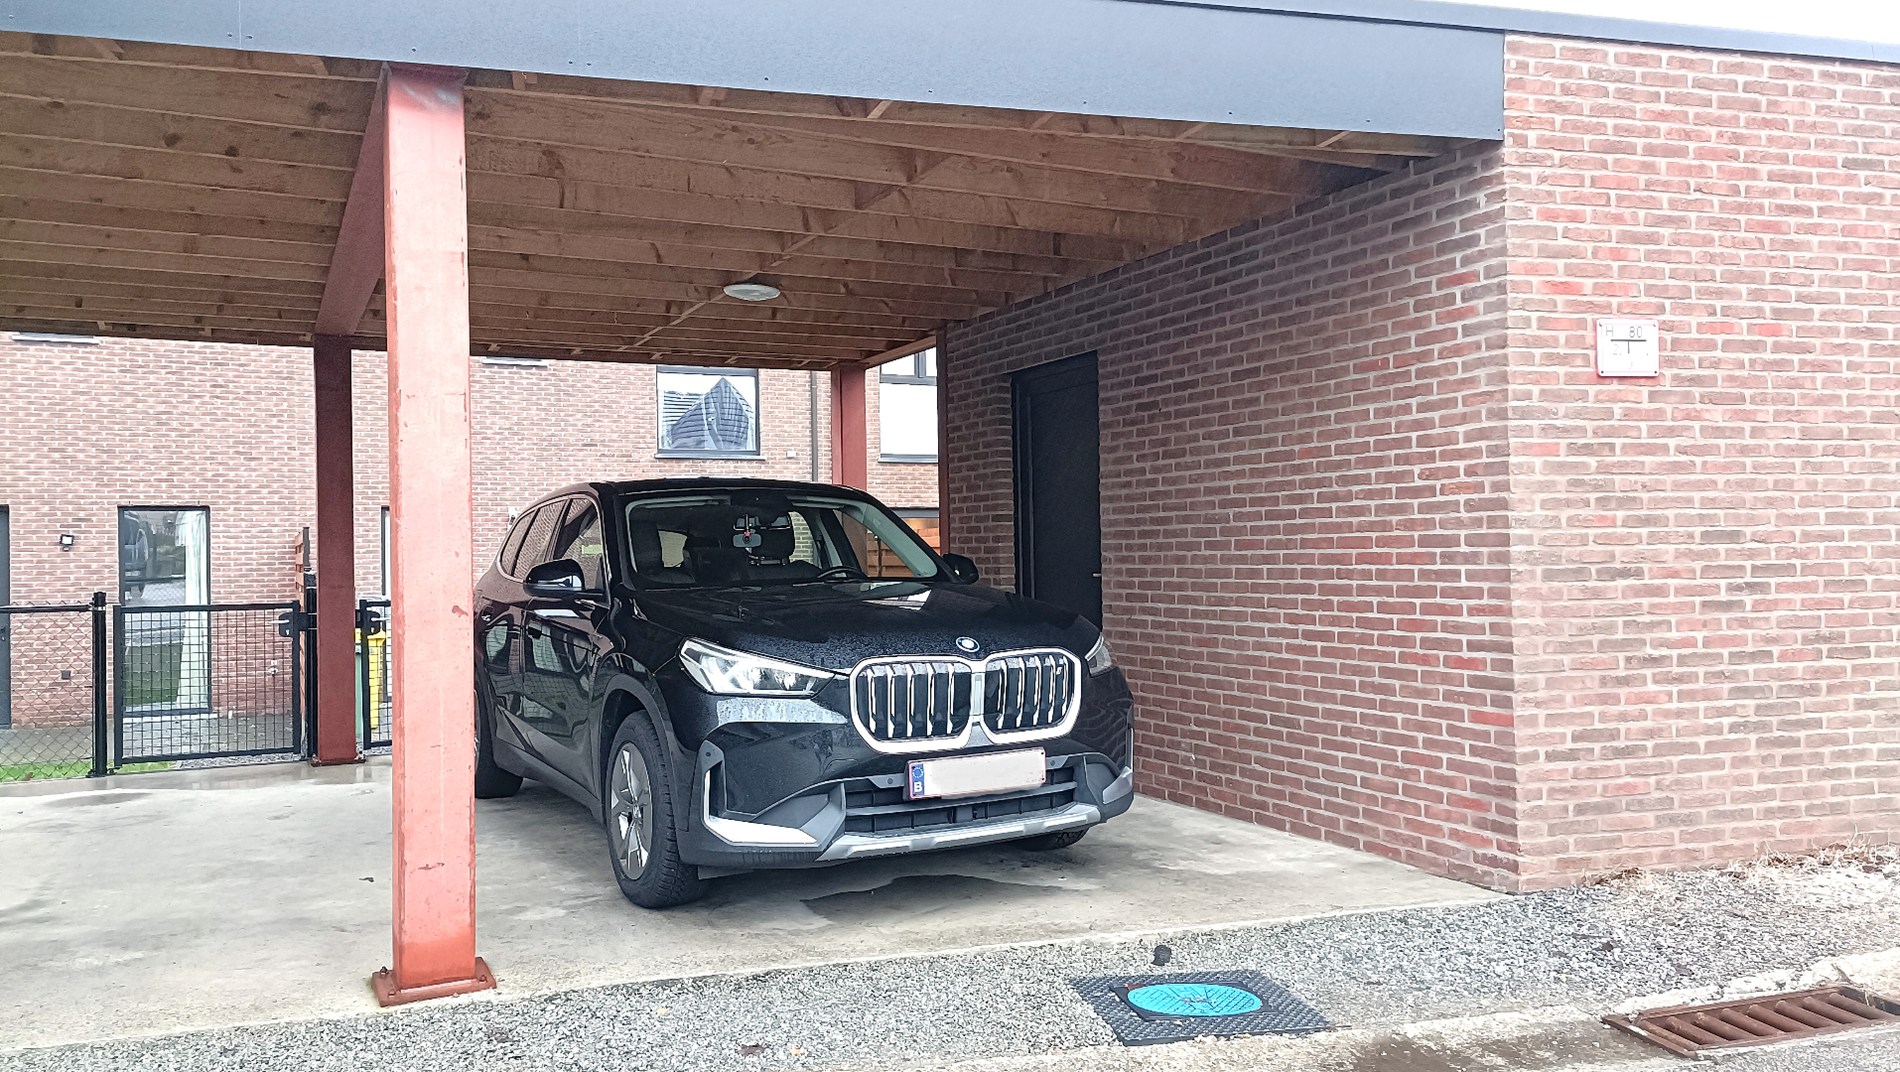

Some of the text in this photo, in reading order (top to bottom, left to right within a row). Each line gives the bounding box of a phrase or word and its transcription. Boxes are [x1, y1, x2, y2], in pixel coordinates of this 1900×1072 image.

[1605, 326, 1643, 338] H 80
[913, 781, 923, 793] B
